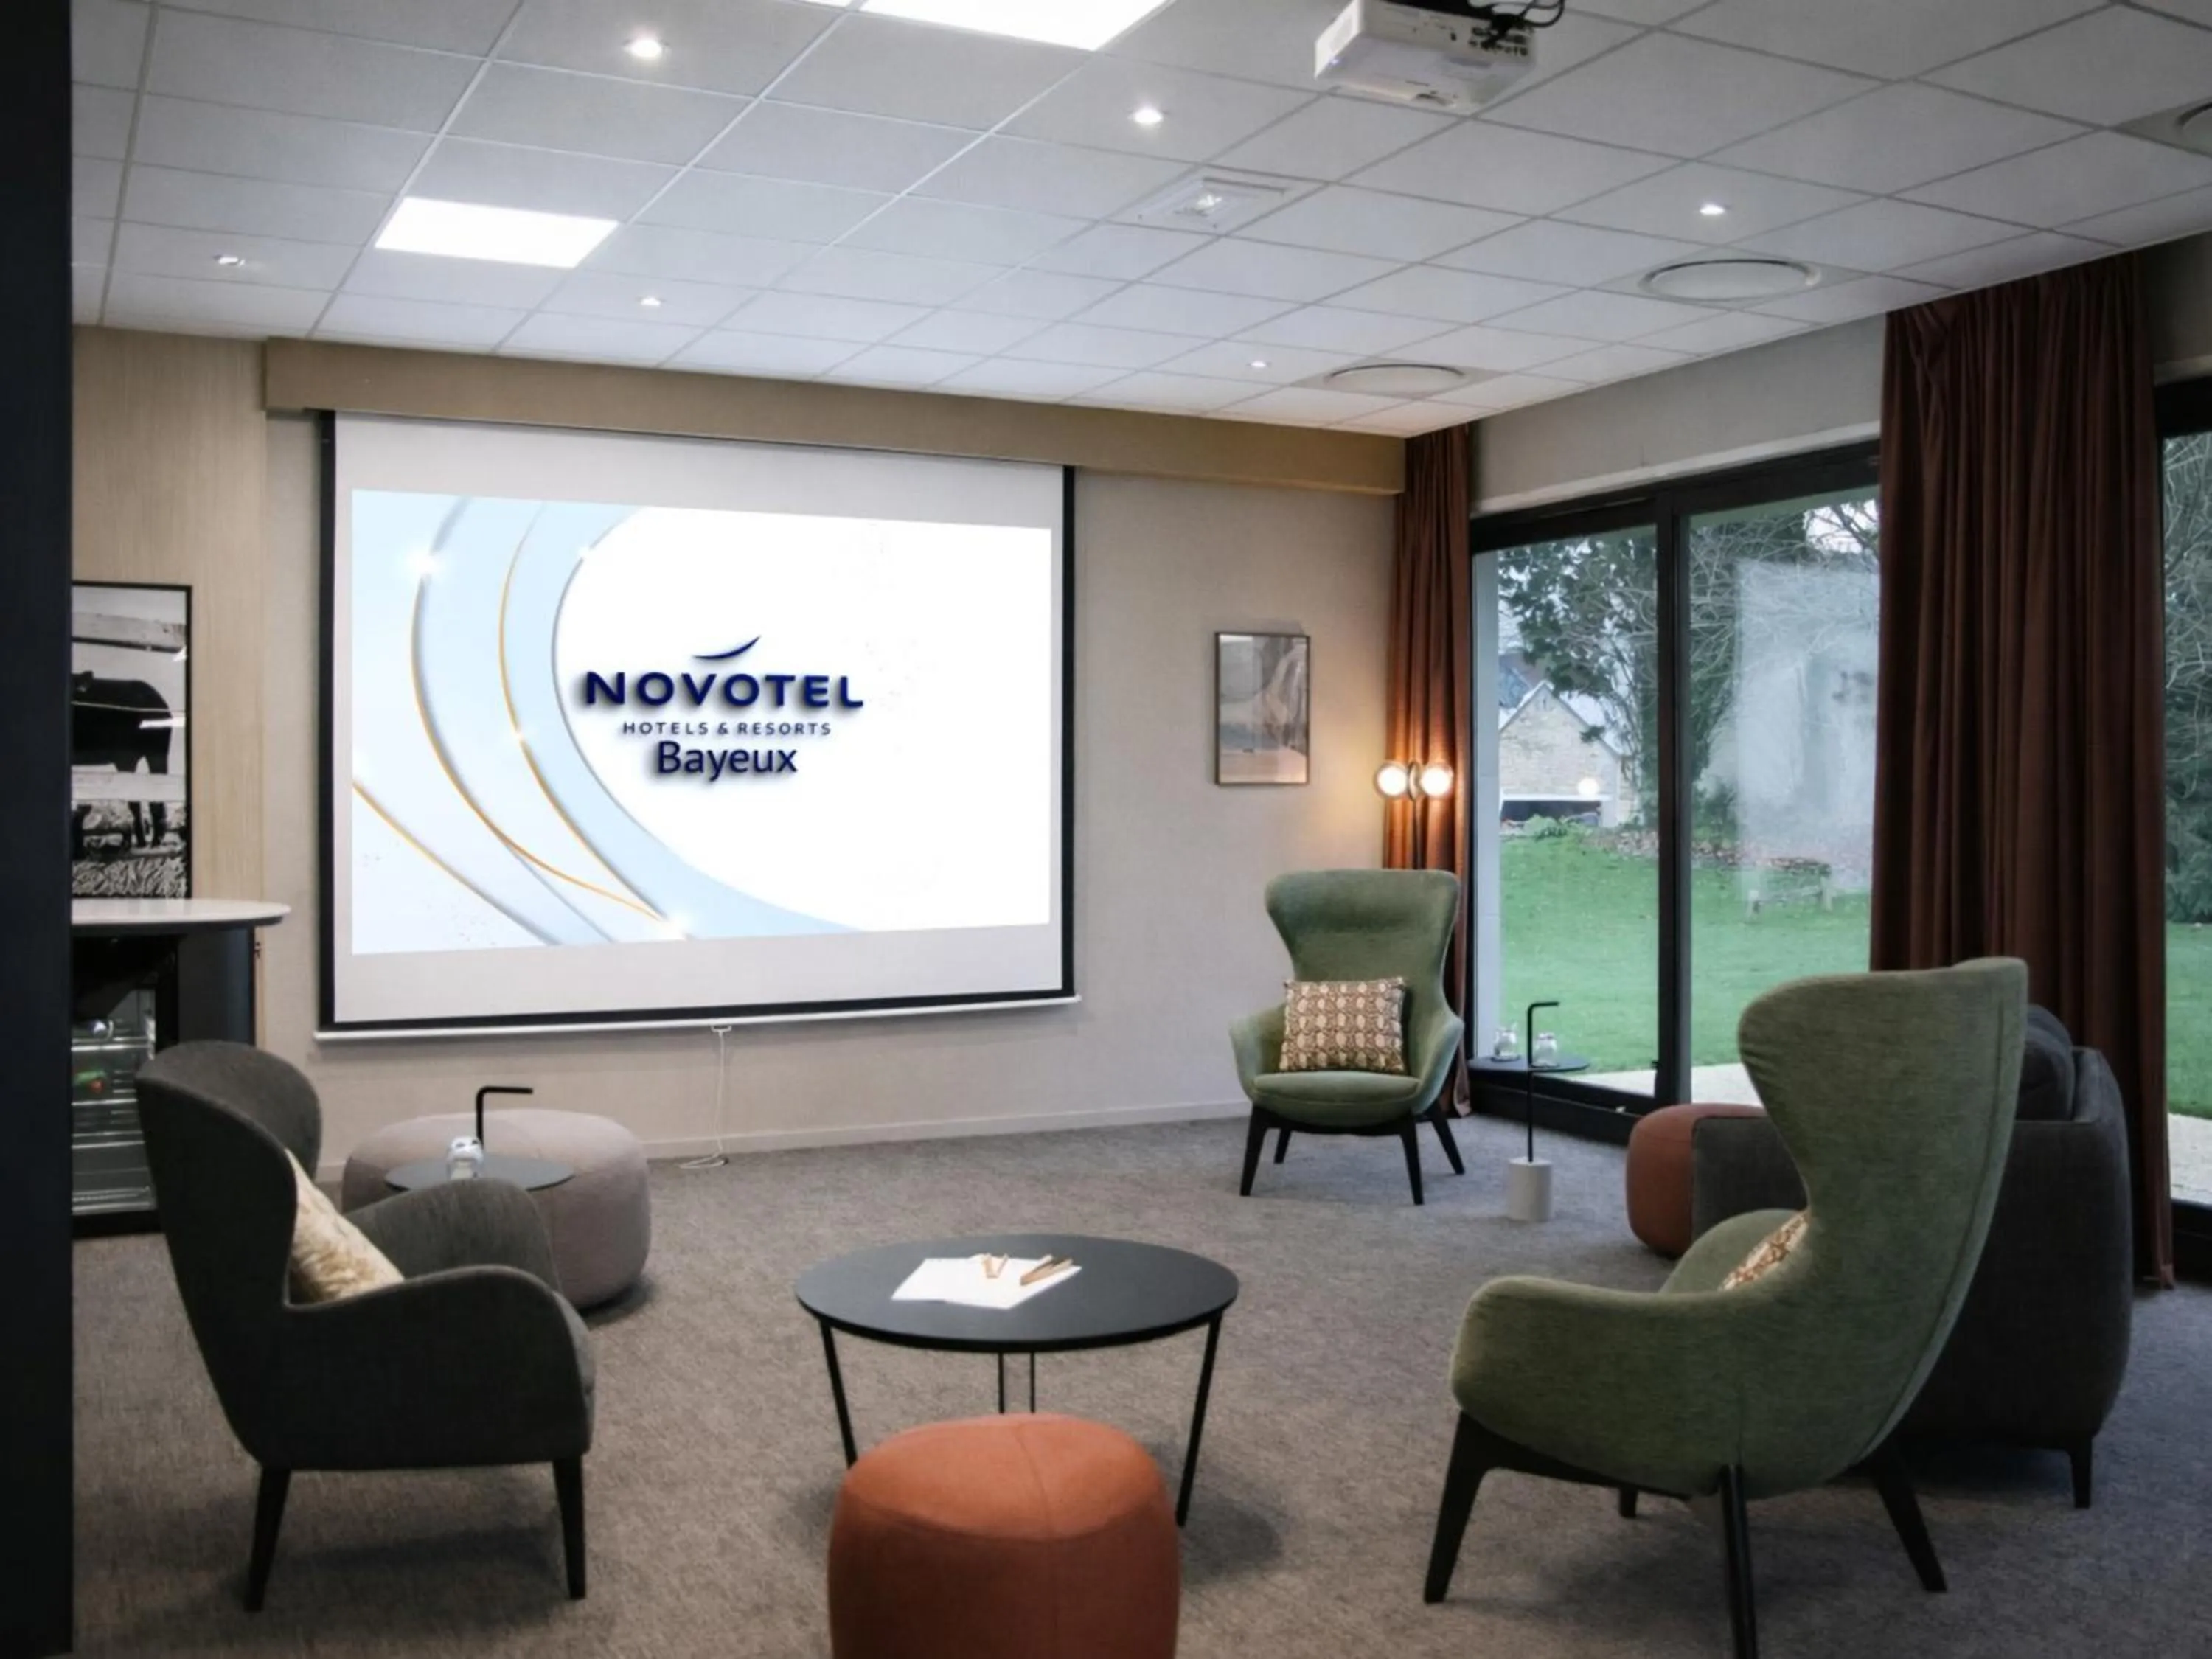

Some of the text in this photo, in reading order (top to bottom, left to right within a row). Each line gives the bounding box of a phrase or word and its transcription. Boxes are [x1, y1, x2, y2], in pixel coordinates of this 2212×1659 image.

[585, 672, 863, 708] NOVOTEL
[622, 721, 831, 736] HOTELS & RESORTS
[656, 740, 798, 782] Bayeux
